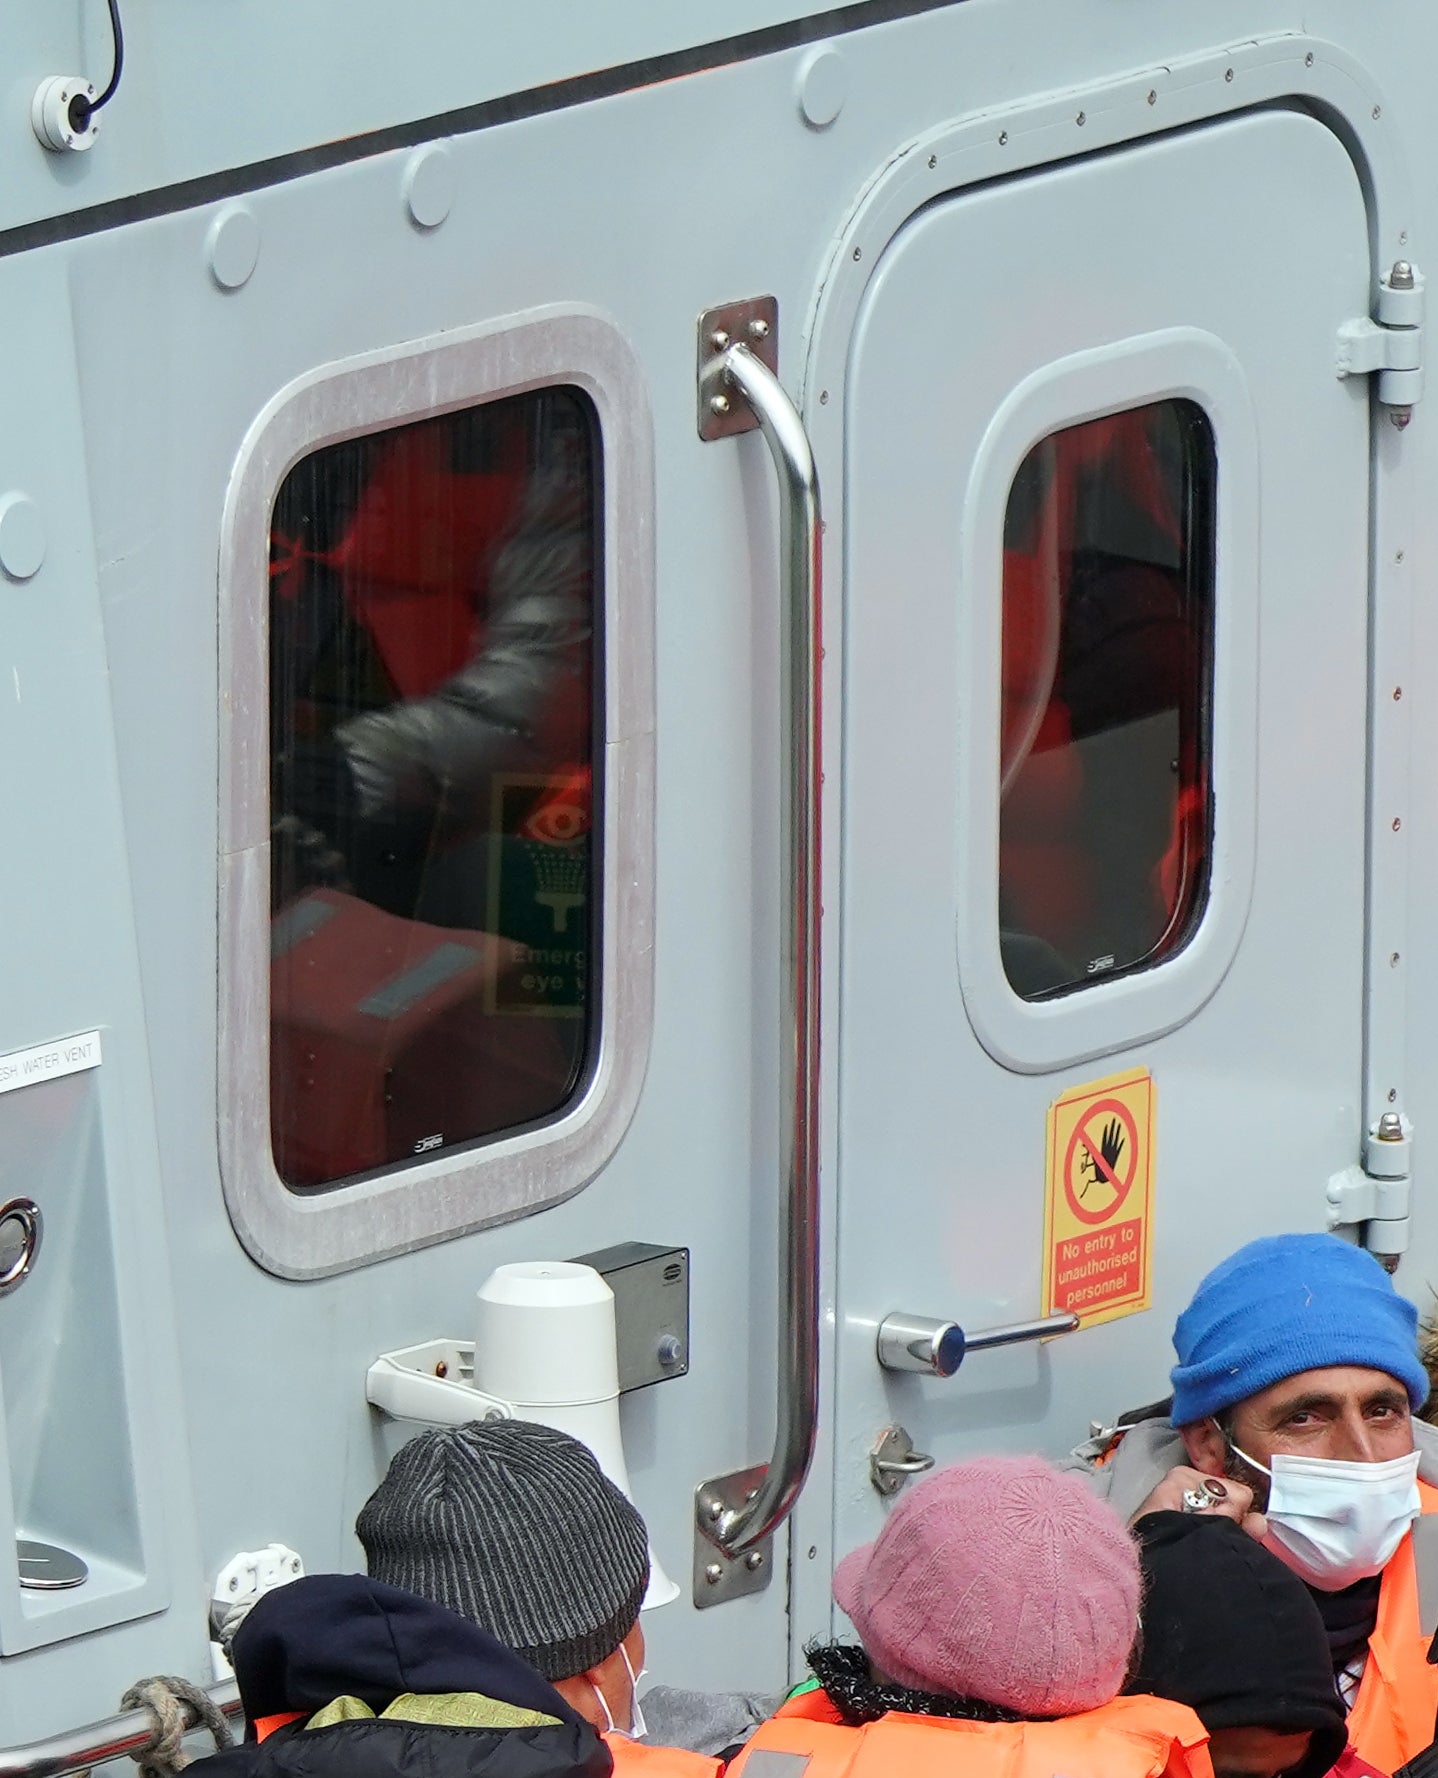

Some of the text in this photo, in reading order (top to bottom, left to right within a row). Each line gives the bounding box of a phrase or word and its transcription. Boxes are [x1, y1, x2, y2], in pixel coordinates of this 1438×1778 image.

[22, 1052, 60, 1075] WATER
[64, 1042, 93, 1063] VENT
[1062, 1227, 1134, 1261] No entry to
[1058, 1246, 1137, 1285] unauthorised
[1066, 1272, 1128, 1308] personnel
